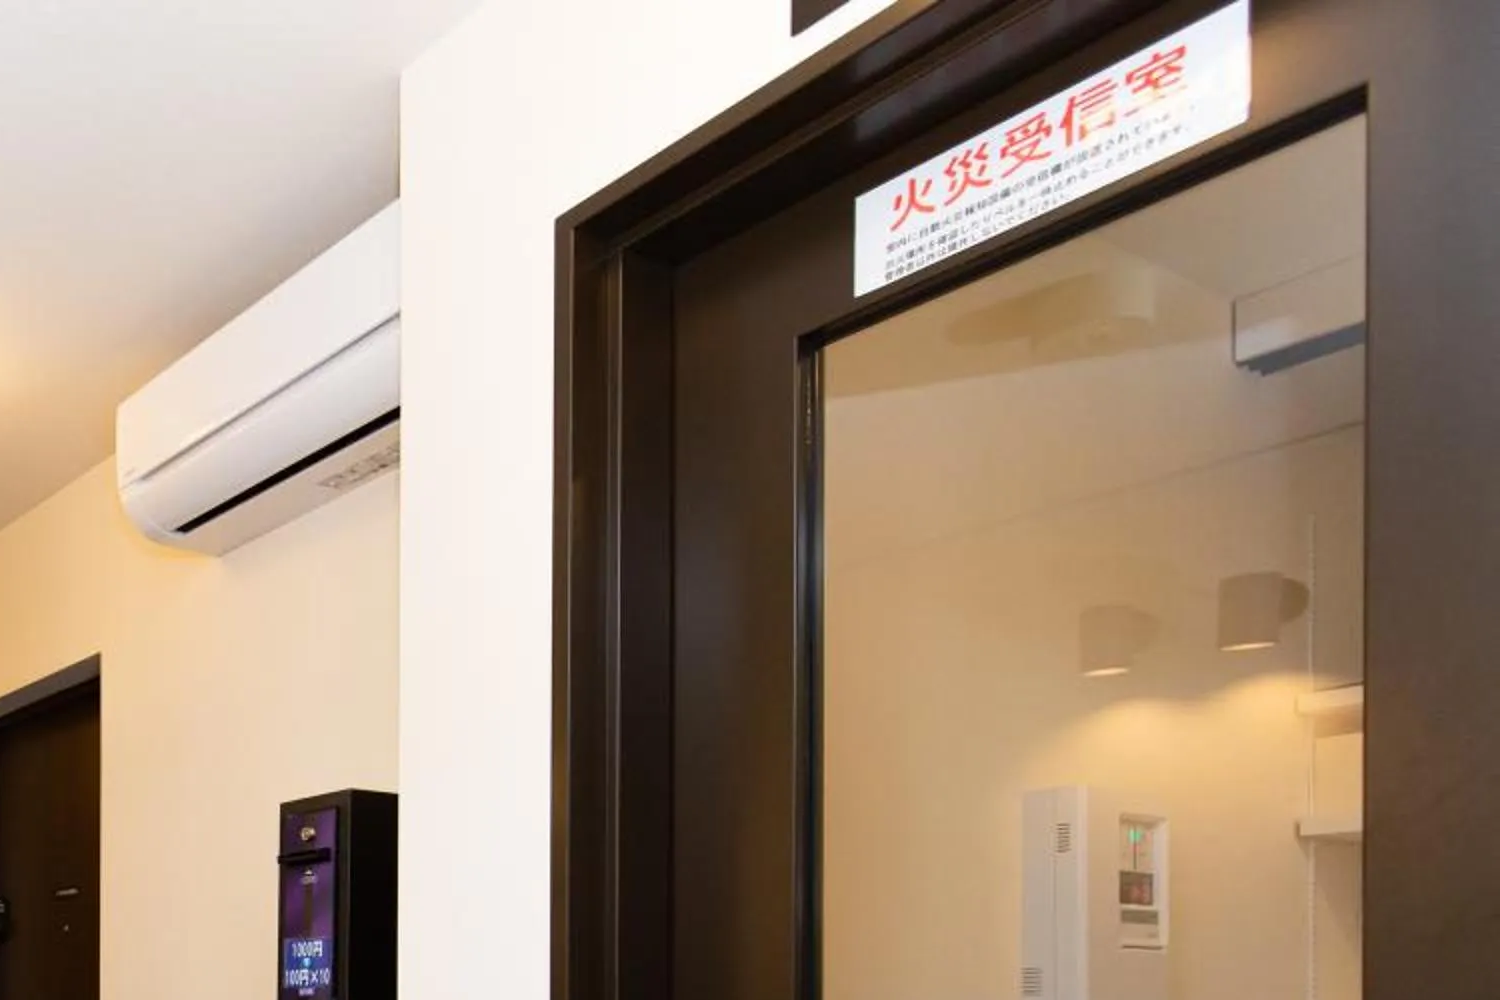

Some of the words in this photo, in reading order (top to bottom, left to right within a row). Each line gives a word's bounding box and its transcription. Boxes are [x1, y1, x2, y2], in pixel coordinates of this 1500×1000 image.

[890, 44, 1189, 232] 火災受信室
